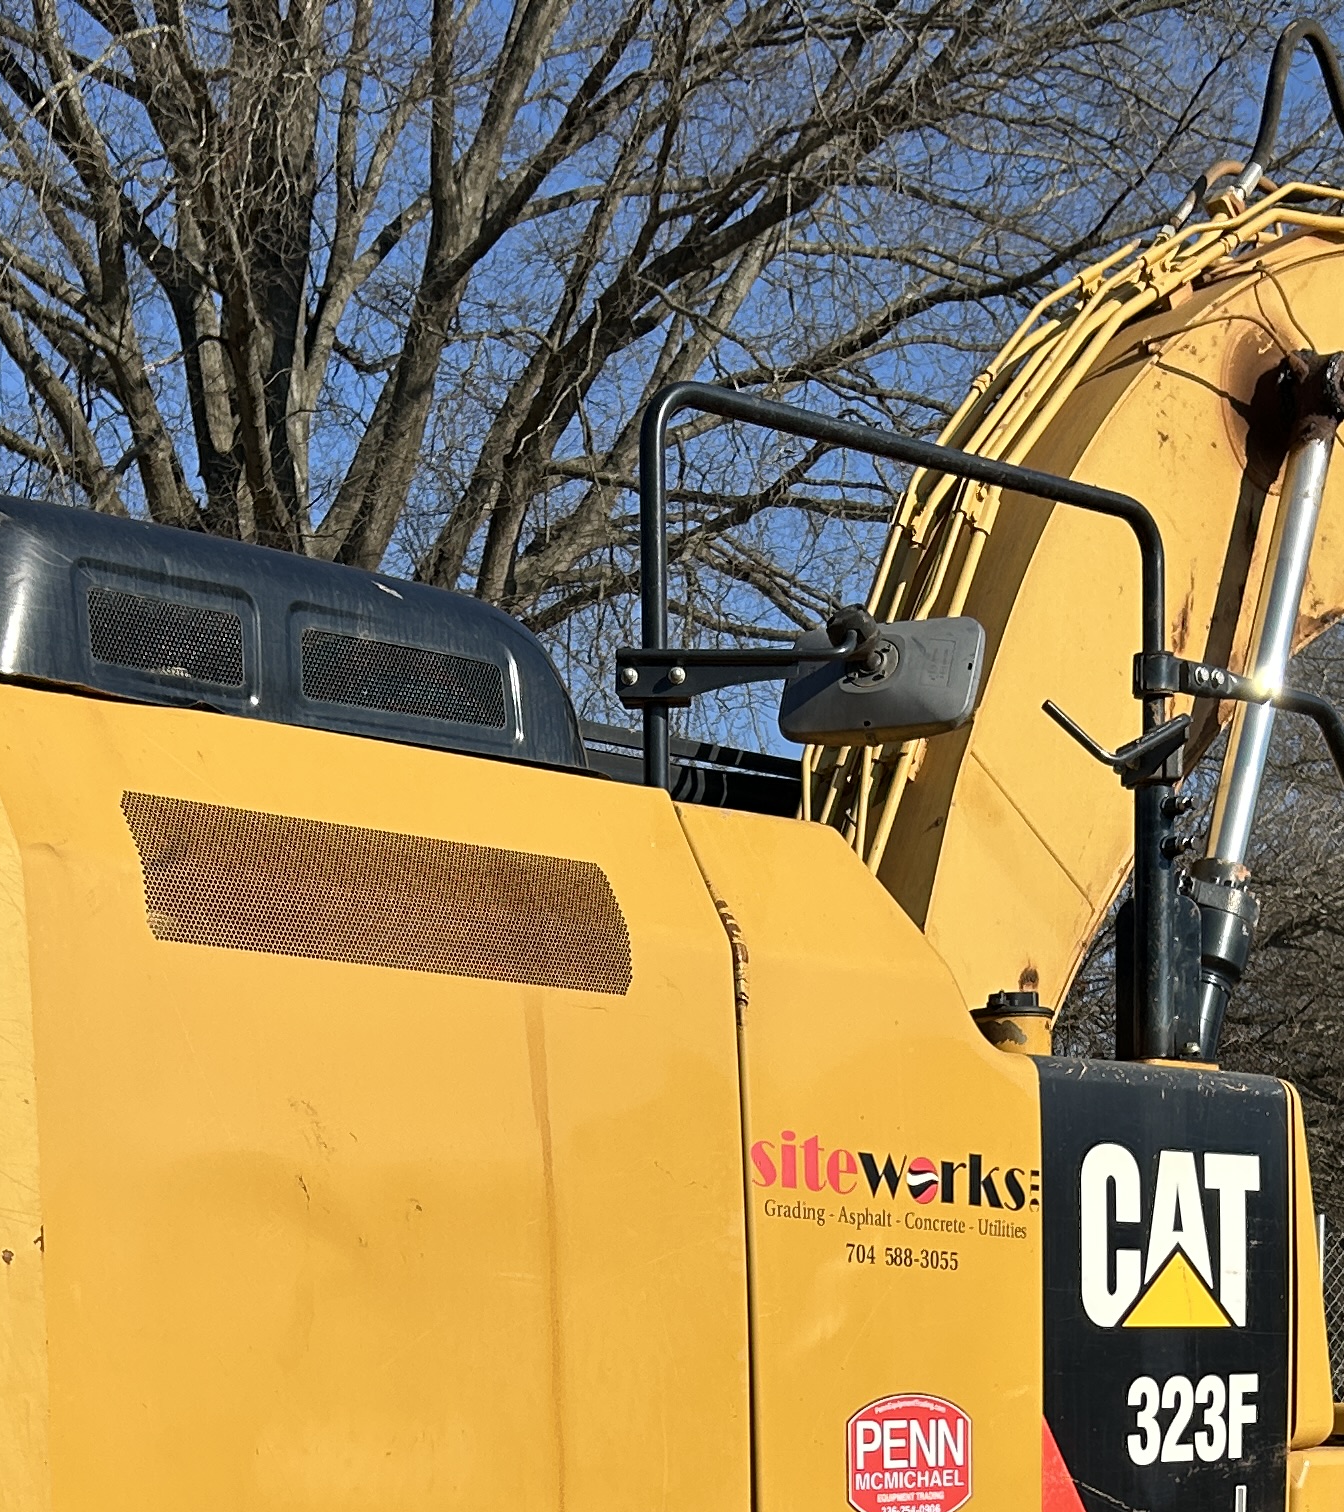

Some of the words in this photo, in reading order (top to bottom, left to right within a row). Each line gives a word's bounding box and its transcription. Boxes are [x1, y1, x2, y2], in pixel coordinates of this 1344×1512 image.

[750, 1130, 1026, 1211] siteworks
[764, 1199, 826, 1226] Grading
[838, 1206, 892, 1230] Asphalt
[905, 1212, 966, 1234] Concrete
[978, 1218, 1028, 1240] Utilities
[1080, 1143, 1261, 1328] CAT
[846, 1243, 876, 1265] 704
[885, 1247, 959, 1271] 588-3055
[856, 1418, 964, 1470] PENN
[1127, 1374, 1259, 1466] 323F
[855, 1469, 965, 1490] MCMICHAEL
